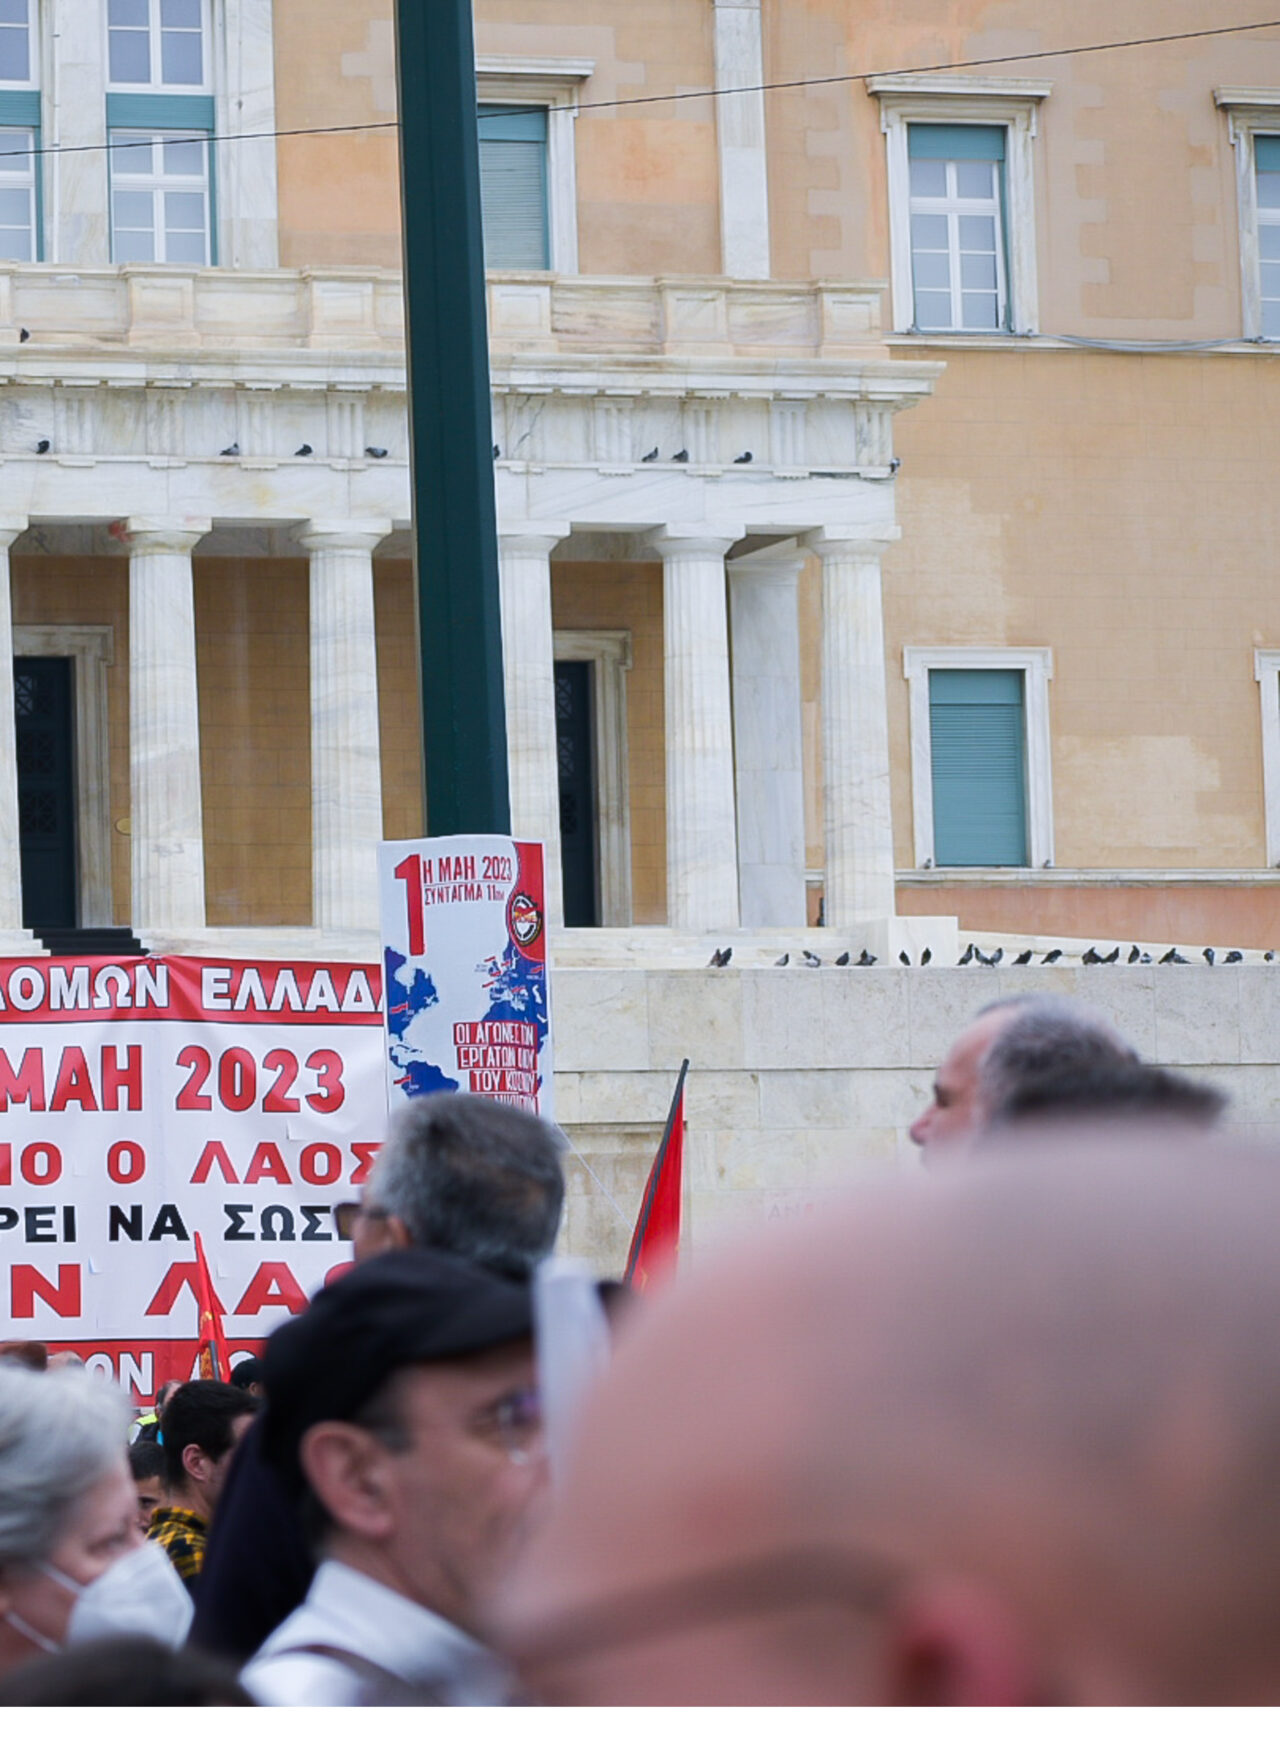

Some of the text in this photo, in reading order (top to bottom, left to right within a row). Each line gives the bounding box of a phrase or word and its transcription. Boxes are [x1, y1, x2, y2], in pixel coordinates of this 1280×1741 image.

[438, 855, 475, 883] ΜΑΗ
[481, 855, 513, 881] 2023
[424, 882, 483, 906] ΣΥΝΤΑΓΜΑ
[201, 967, 383, 1013] ΕΛΛΑΔ
[456, 1023, 470, 1044] ΟΙ
[175, 1045, 345, 1113] 2023
[473, 1070, 501, 1092] ΤΟΥ
[106, 1140, 147, 1185] Ο
[108, 1204, 190, 1242] ΝΑ
[223, 1204, 354, 1241] ΣΩΣ
